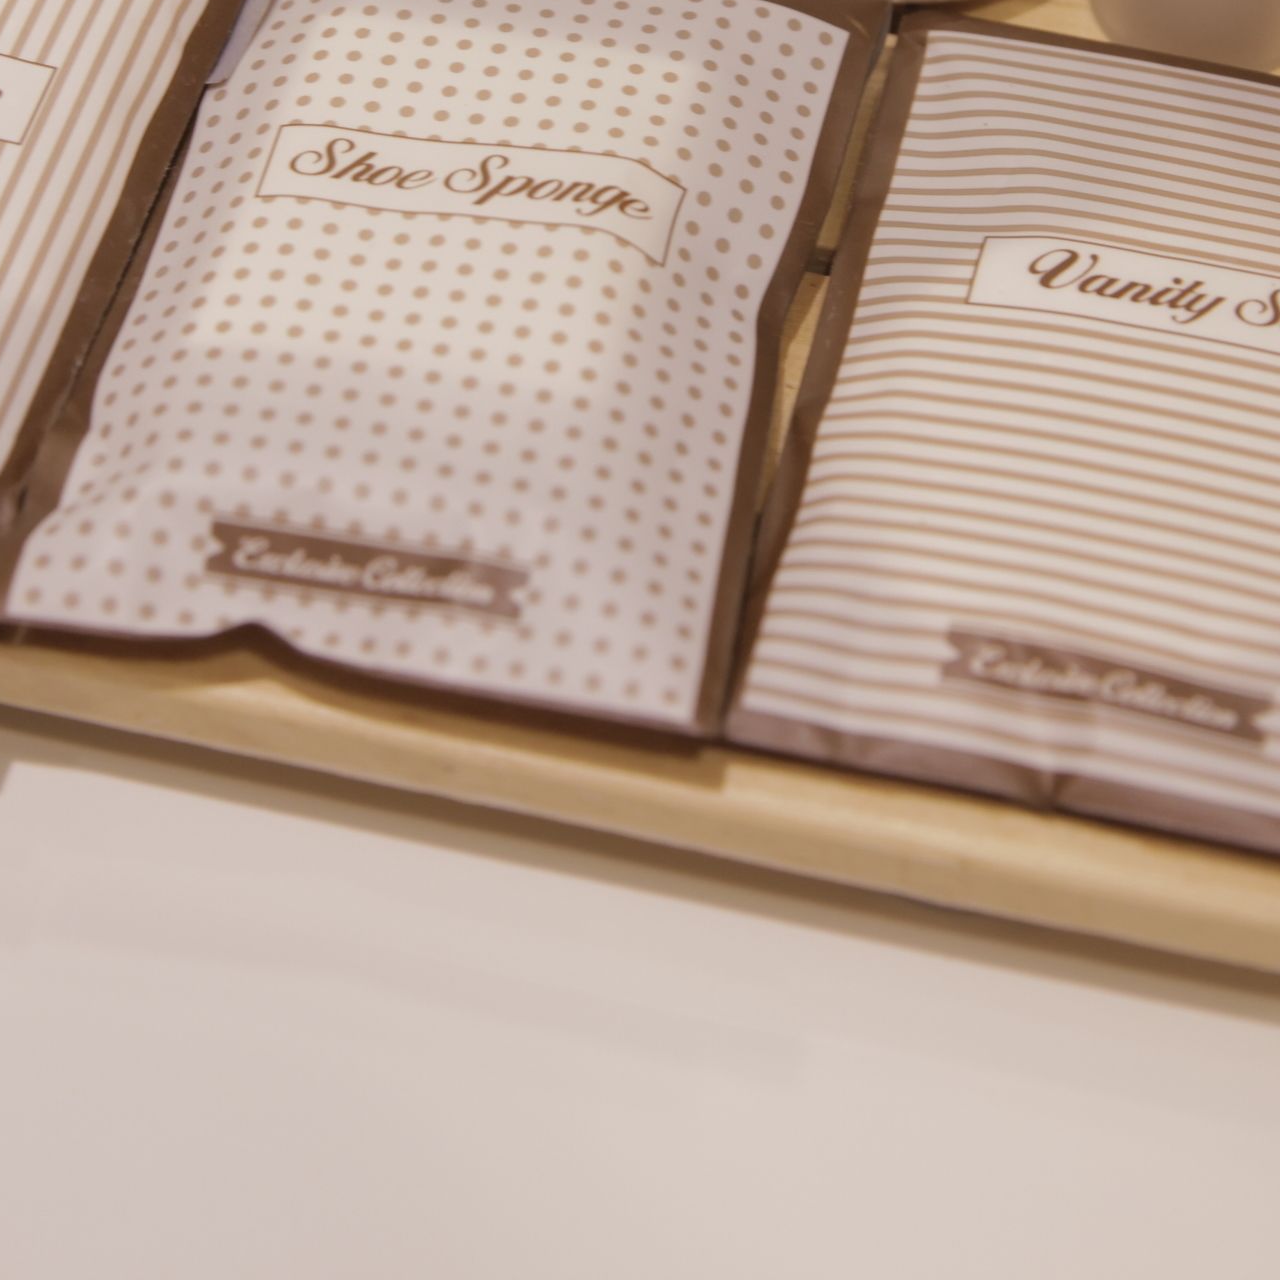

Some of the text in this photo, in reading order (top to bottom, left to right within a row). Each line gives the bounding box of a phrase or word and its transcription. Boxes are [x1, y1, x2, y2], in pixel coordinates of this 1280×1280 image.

[289, 137, 653, 220] Shoe Sponge
[1027, 248, 1227, 325] Vanity
